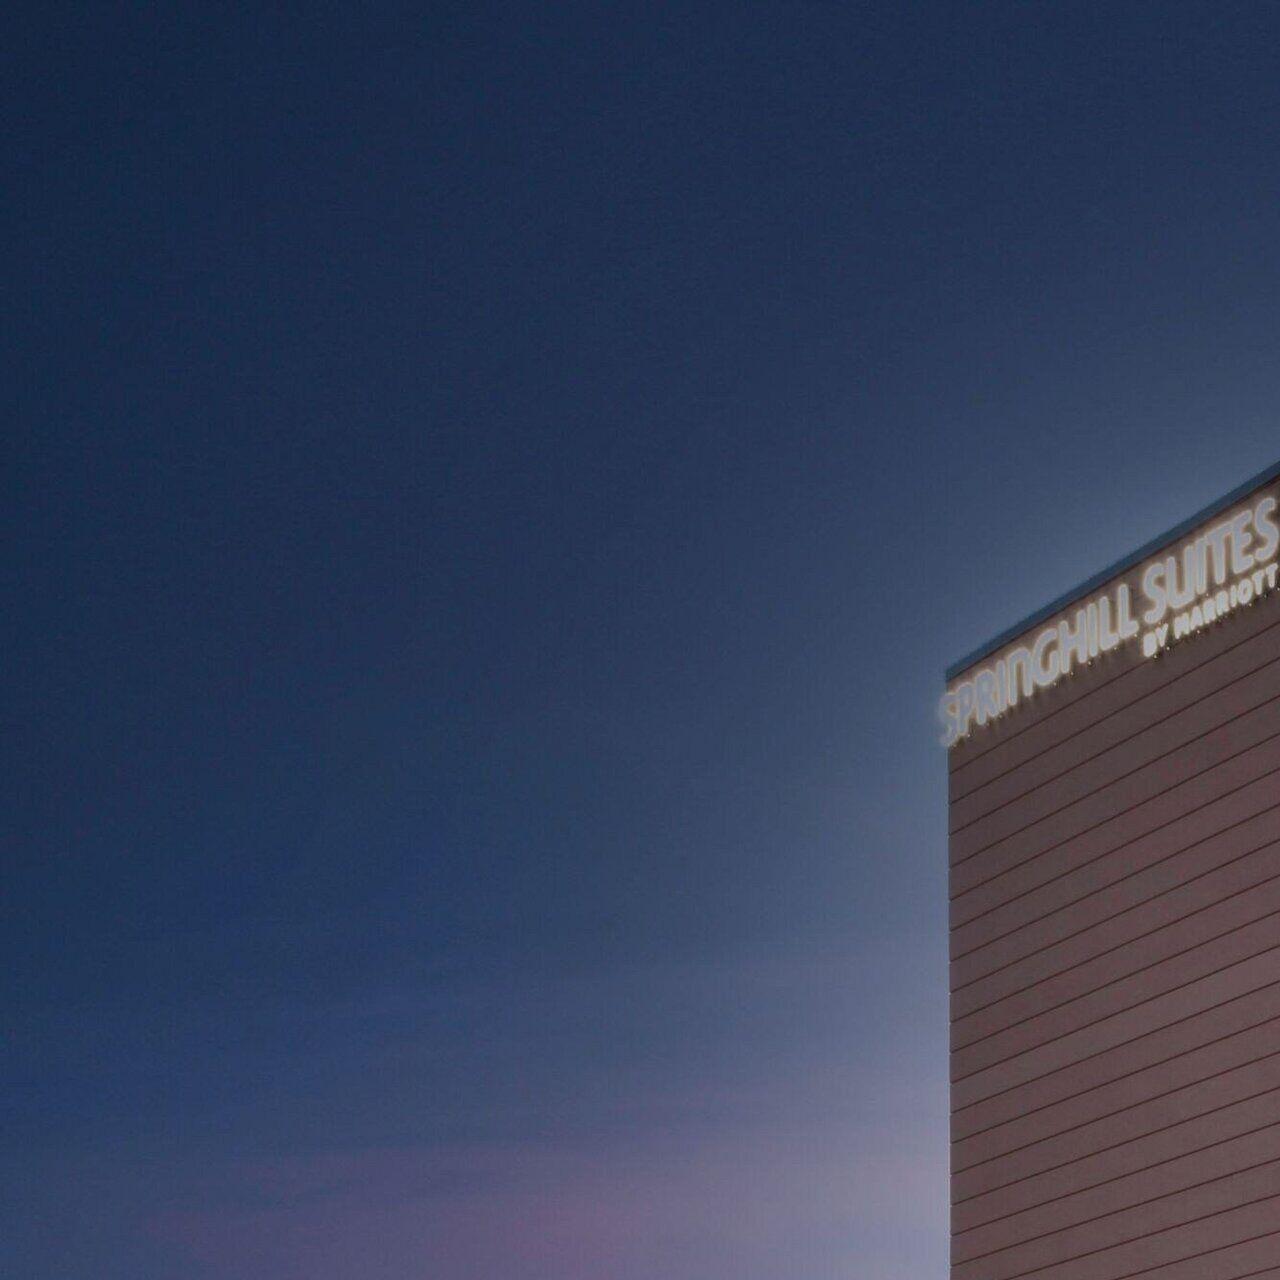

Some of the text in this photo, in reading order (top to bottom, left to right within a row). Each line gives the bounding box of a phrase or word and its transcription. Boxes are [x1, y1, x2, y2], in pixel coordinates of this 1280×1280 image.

[938, 497, 1279, 748] SPRINGHILL SUITES
[1143, 563, 1279, 658] BY MARRIOTT
